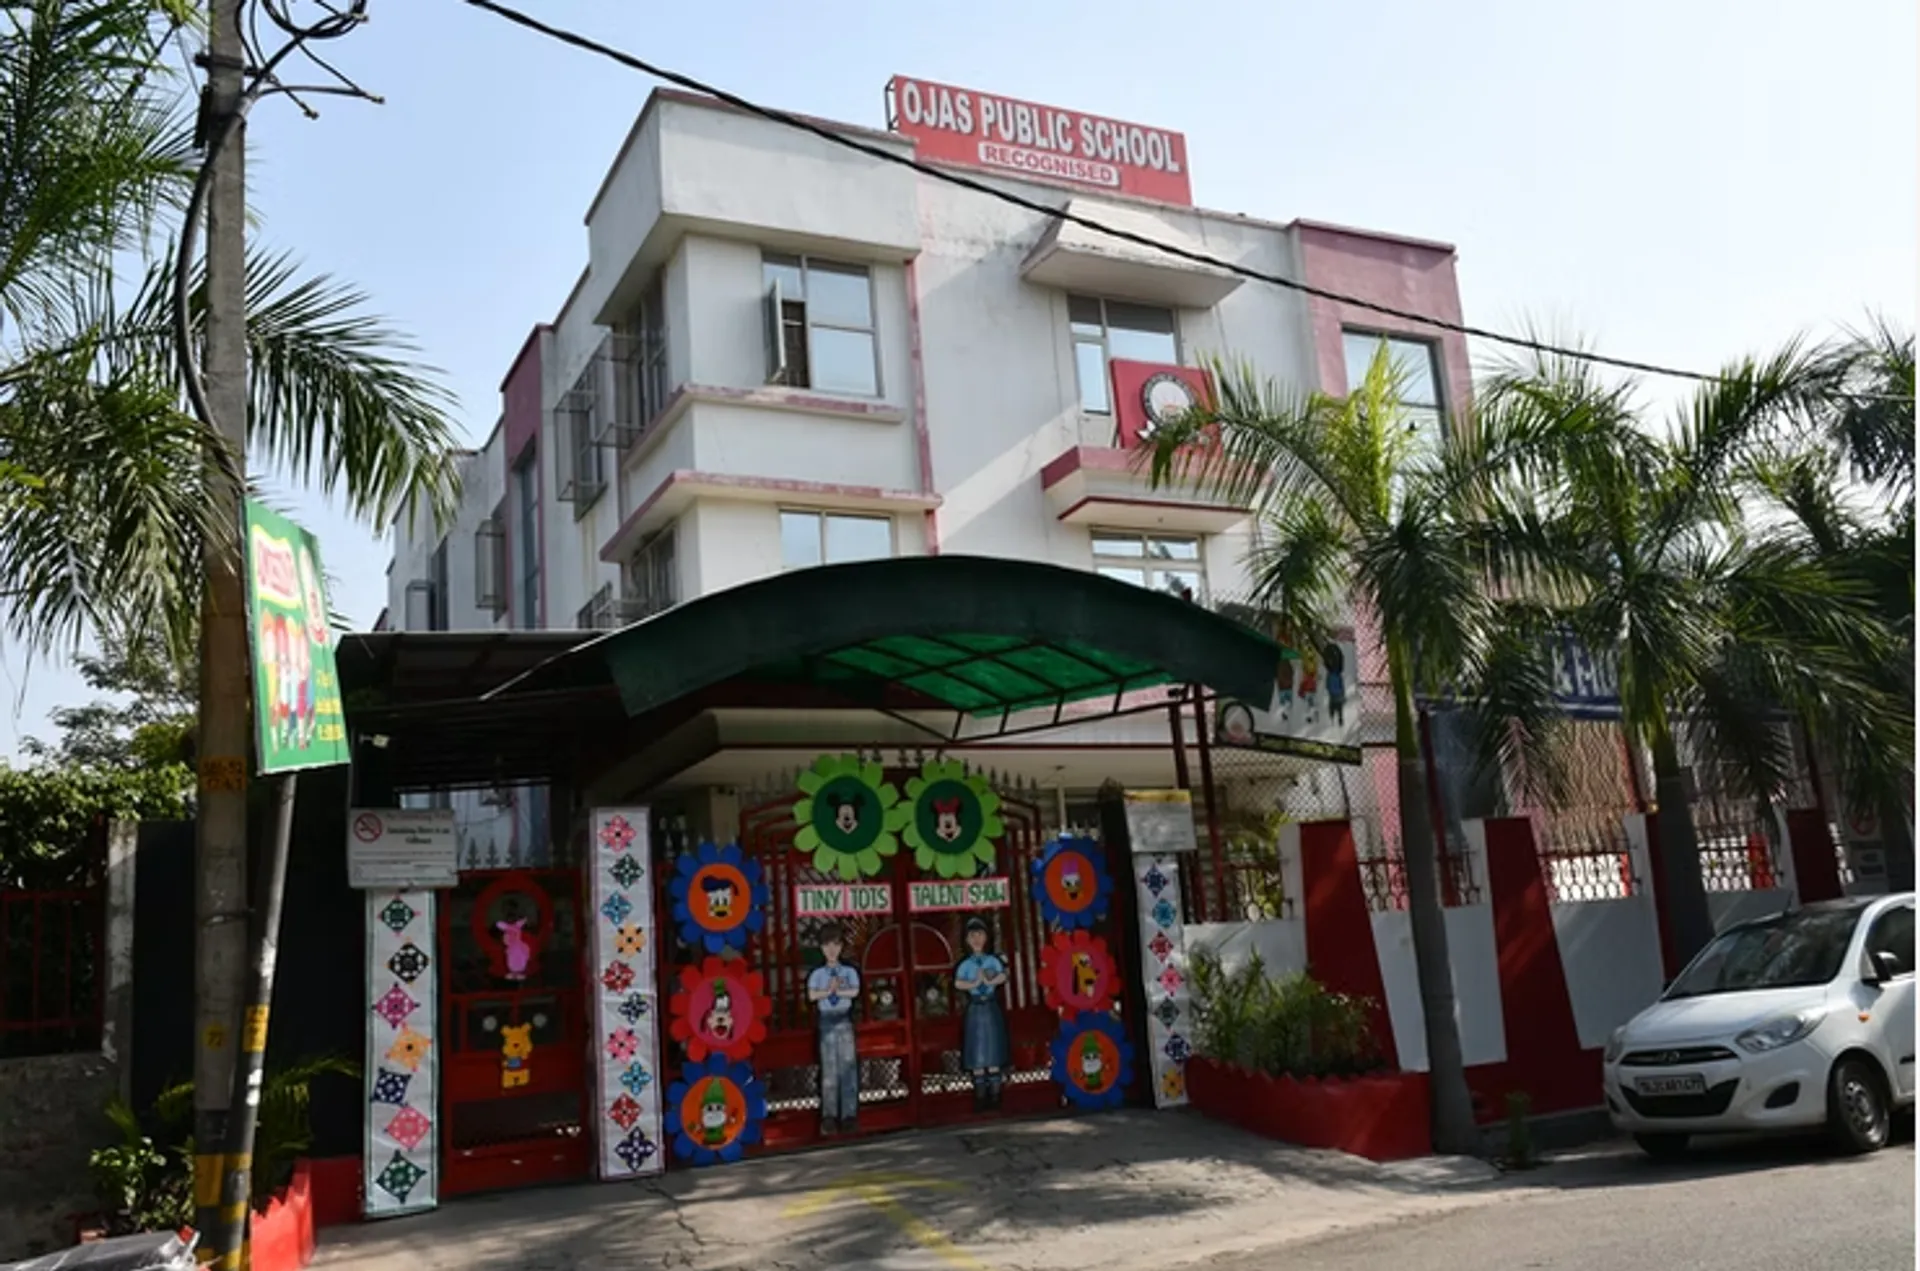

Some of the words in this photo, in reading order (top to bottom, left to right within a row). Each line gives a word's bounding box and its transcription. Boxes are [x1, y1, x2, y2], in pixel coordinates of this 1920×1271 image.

[903, 82, 975, 134] OJAS
[979, 97, 1074, 155] PUBLIC
[1079, 117, 1181, 172] SCHOOL
[983, 144, 1113, 183] RECOGNISED
[800, 889, 842, 912] TINY
[850, 887, 888, 909] TOTS
[911, 883, 964, 908] TALENT
